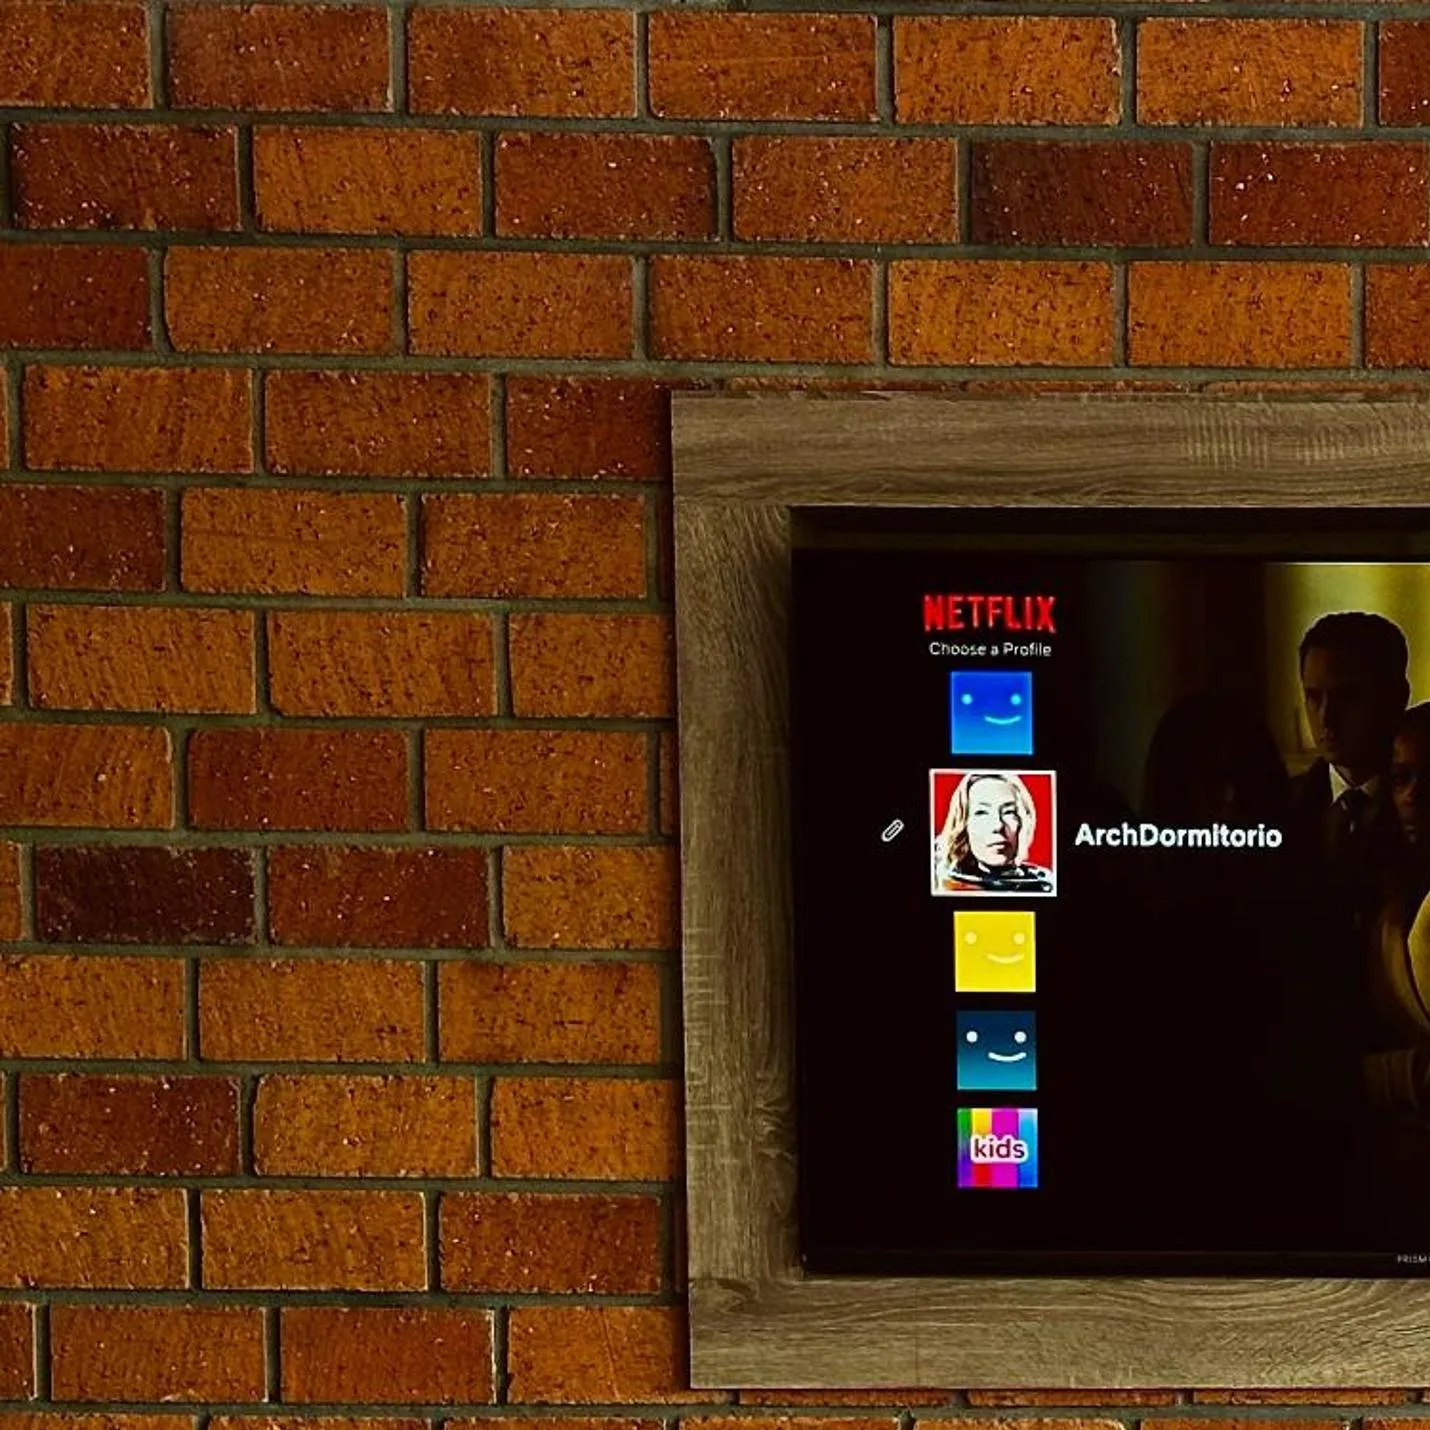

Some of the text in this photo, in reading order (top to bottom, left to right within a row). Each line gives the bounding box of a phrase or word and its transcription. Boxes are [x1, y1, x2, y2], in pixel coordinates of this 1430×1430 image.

[923, 594, 1057, 633] NETFLIX
[928, 641, 1052, 657] Choose a Profile
[1074, 822, 1283, 848] ArchDormitorio
[973, 1137, 1026, 1159] kids
